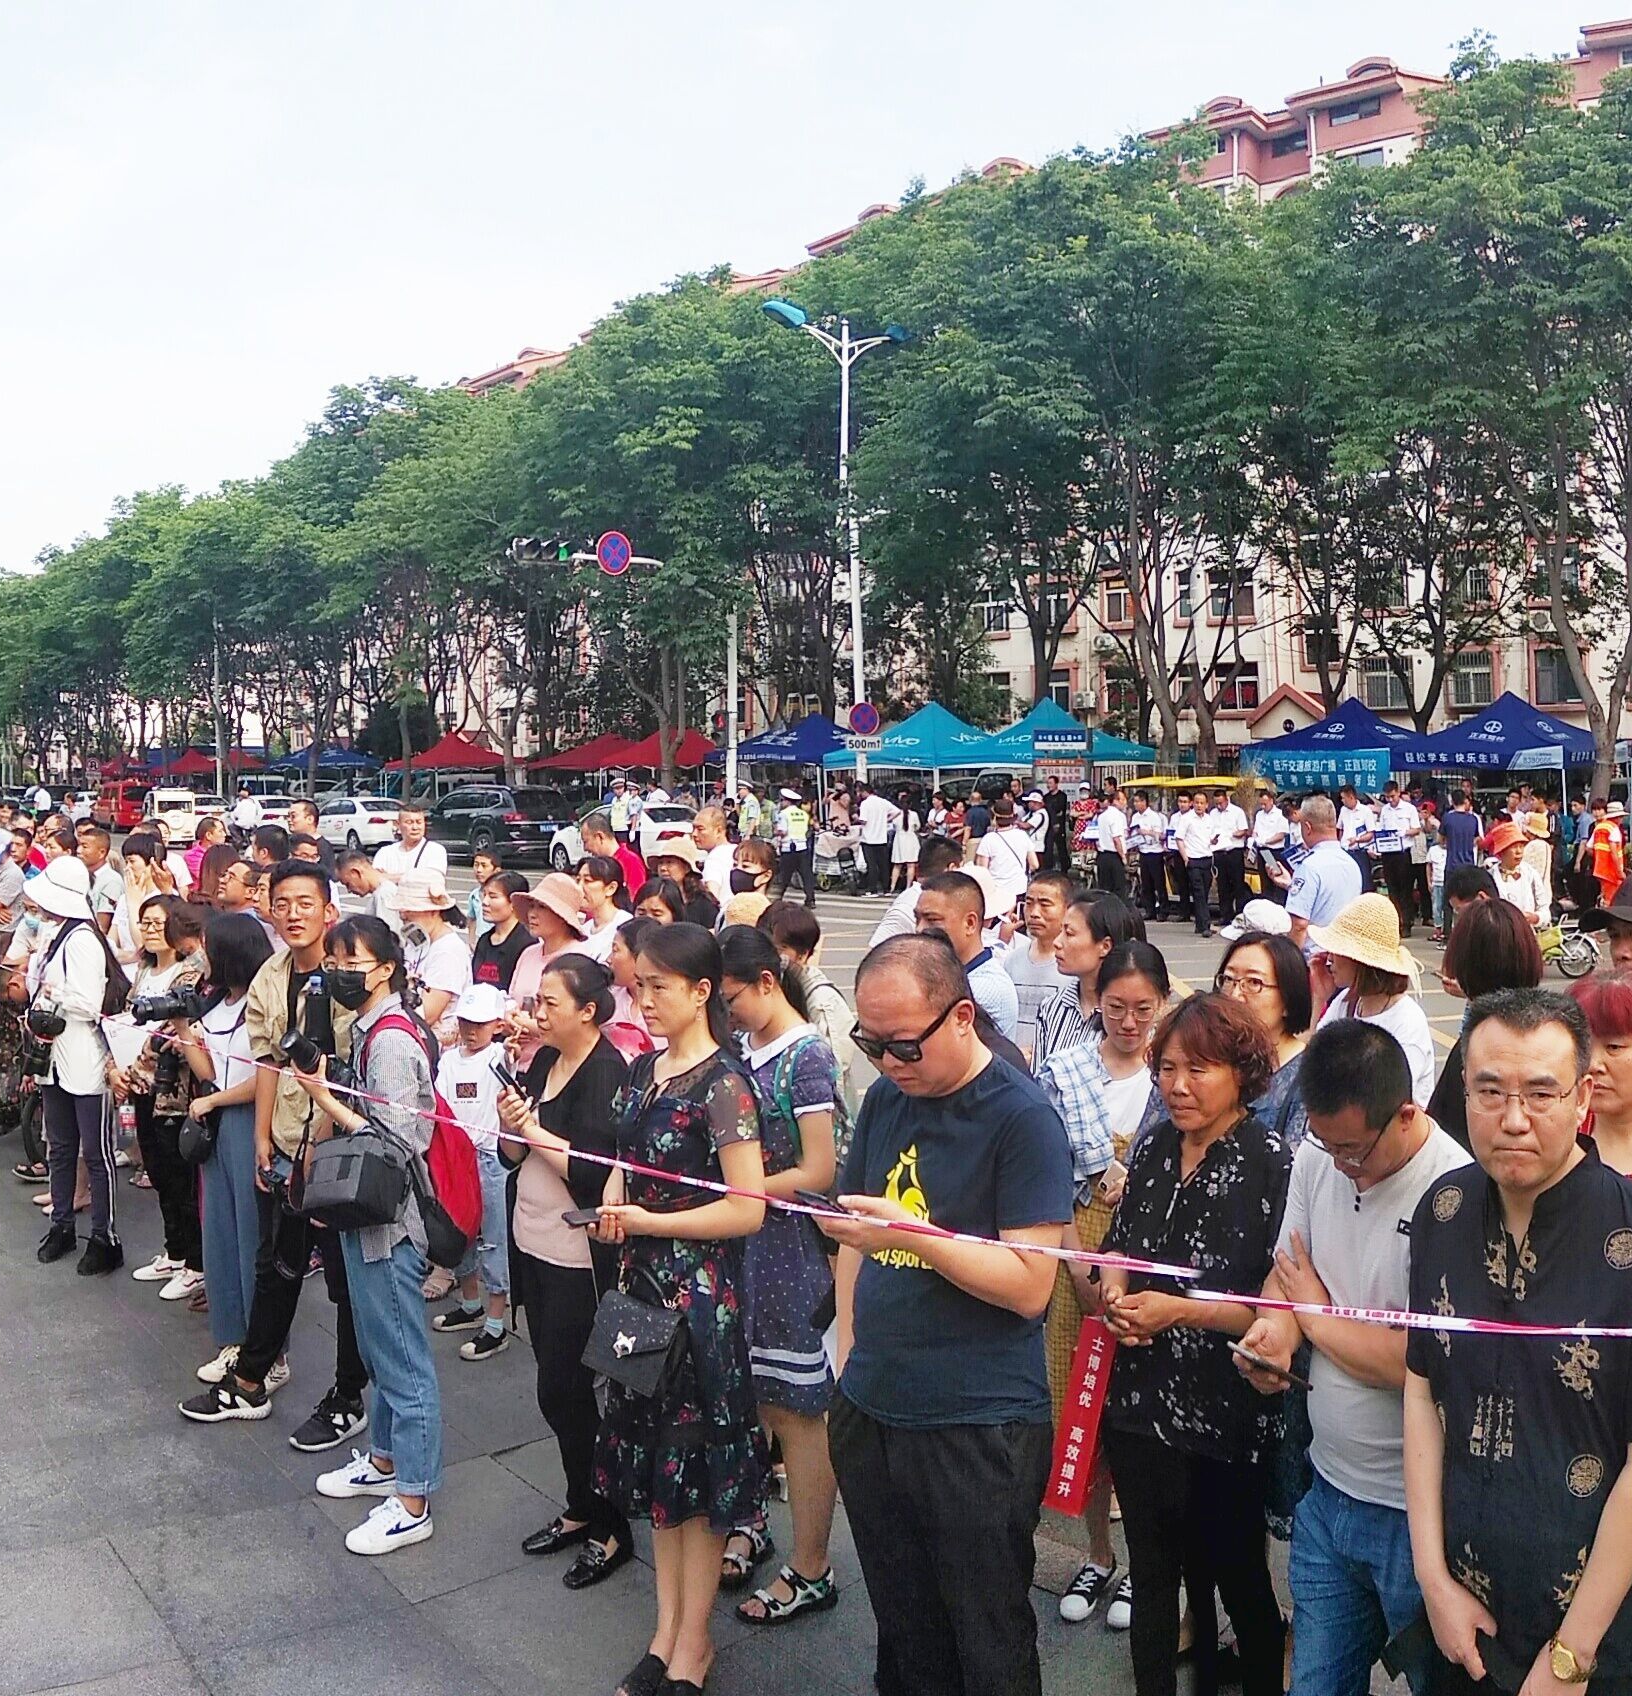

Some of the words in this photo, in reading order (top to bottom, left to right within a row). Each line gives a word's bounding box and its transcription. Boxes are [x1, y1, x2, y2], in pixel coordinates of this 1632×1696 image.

[1405, 752, 1448, 763] 轻松学车
[1455, 752, 1500, 764] 快乐生活
[1078, 1336, 1106, 1409] 士博培优
[1057, 1425, 1085, 1498] 高效提升
